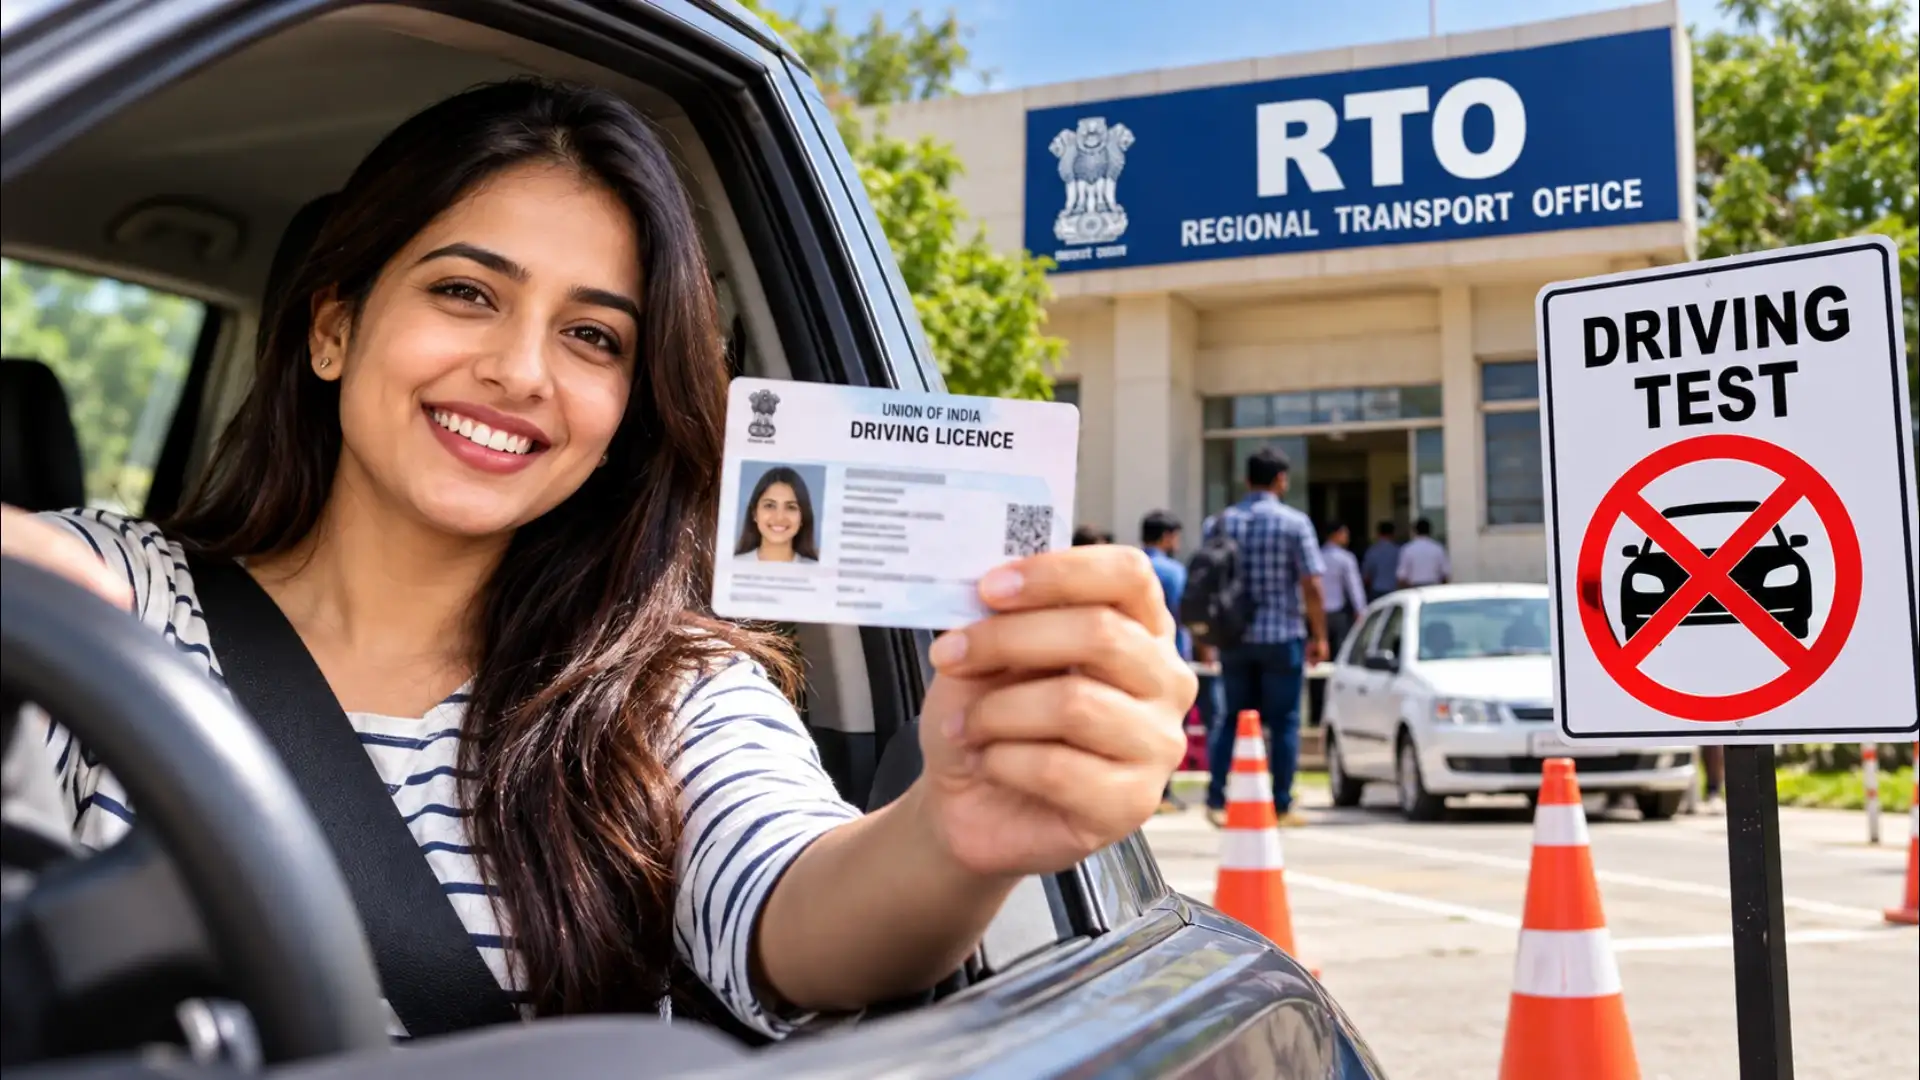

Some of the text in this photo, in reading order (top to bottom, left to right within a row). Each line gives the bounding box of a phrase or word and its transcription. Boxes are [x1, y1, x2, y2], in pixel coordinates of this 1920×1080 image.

[1256, 77, 1527, 197] RTO
[1181, 179, 1644, 247] REGIONAL TRANSPORT OFFICE
[1583, 285, 1850, 368] DRIVING
[882, 403, 981, 423] UNION OF INDIA
[1634, 360, 1799, 429] TEST
[850, 421, 1014, 449] DRIVING LICENCE
